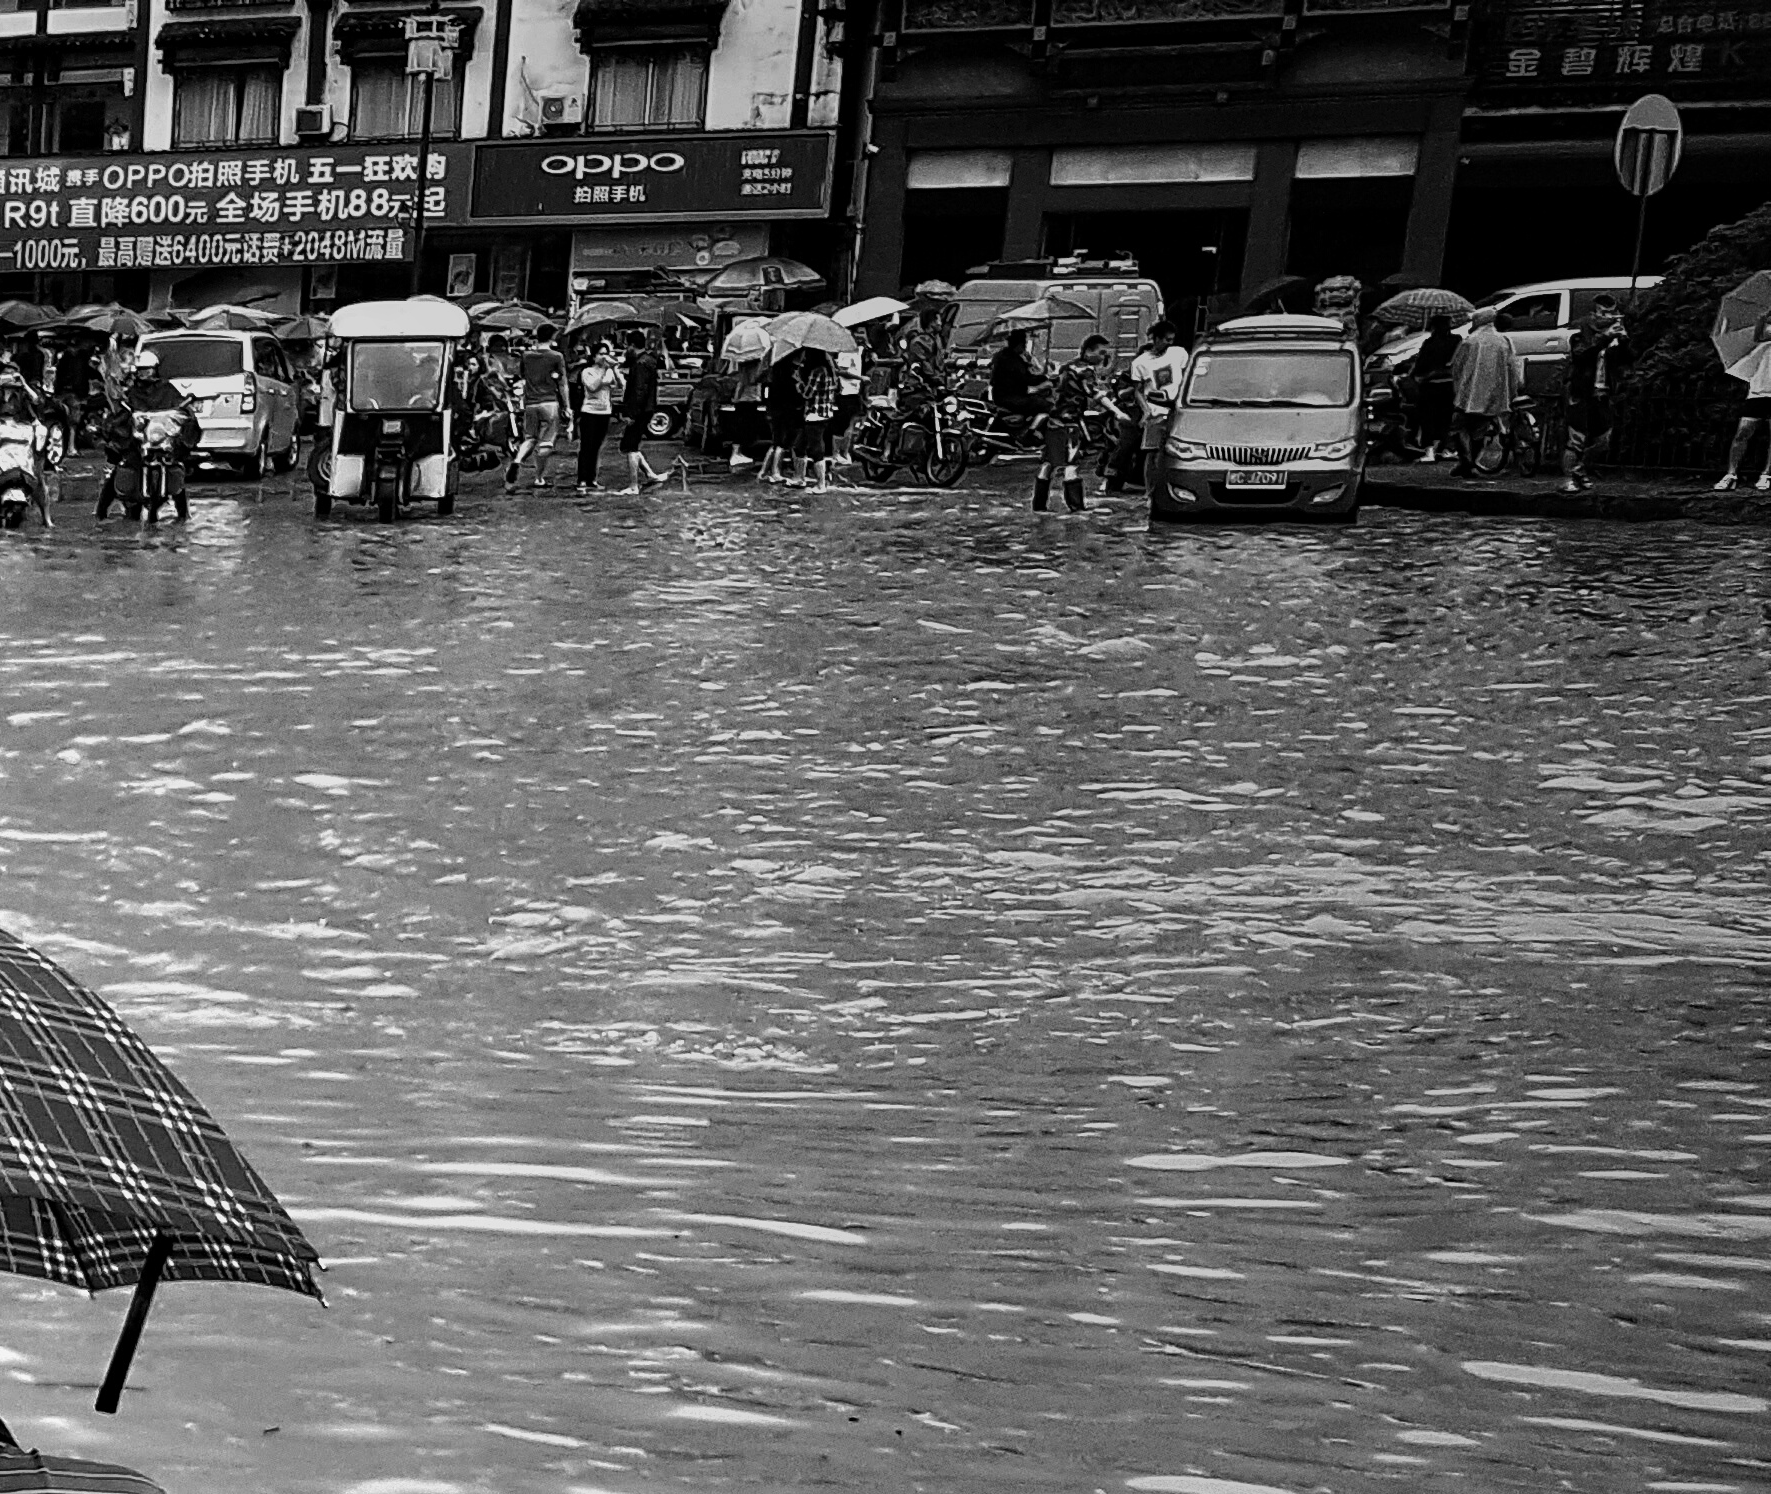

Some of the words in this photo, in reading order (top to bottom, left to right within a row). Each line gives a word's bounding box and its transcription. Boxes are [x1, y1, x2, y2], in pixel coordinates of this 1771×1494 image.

[541, 152, 685, 180] oppo
[573, 185, 646, 204] 拍照手机
